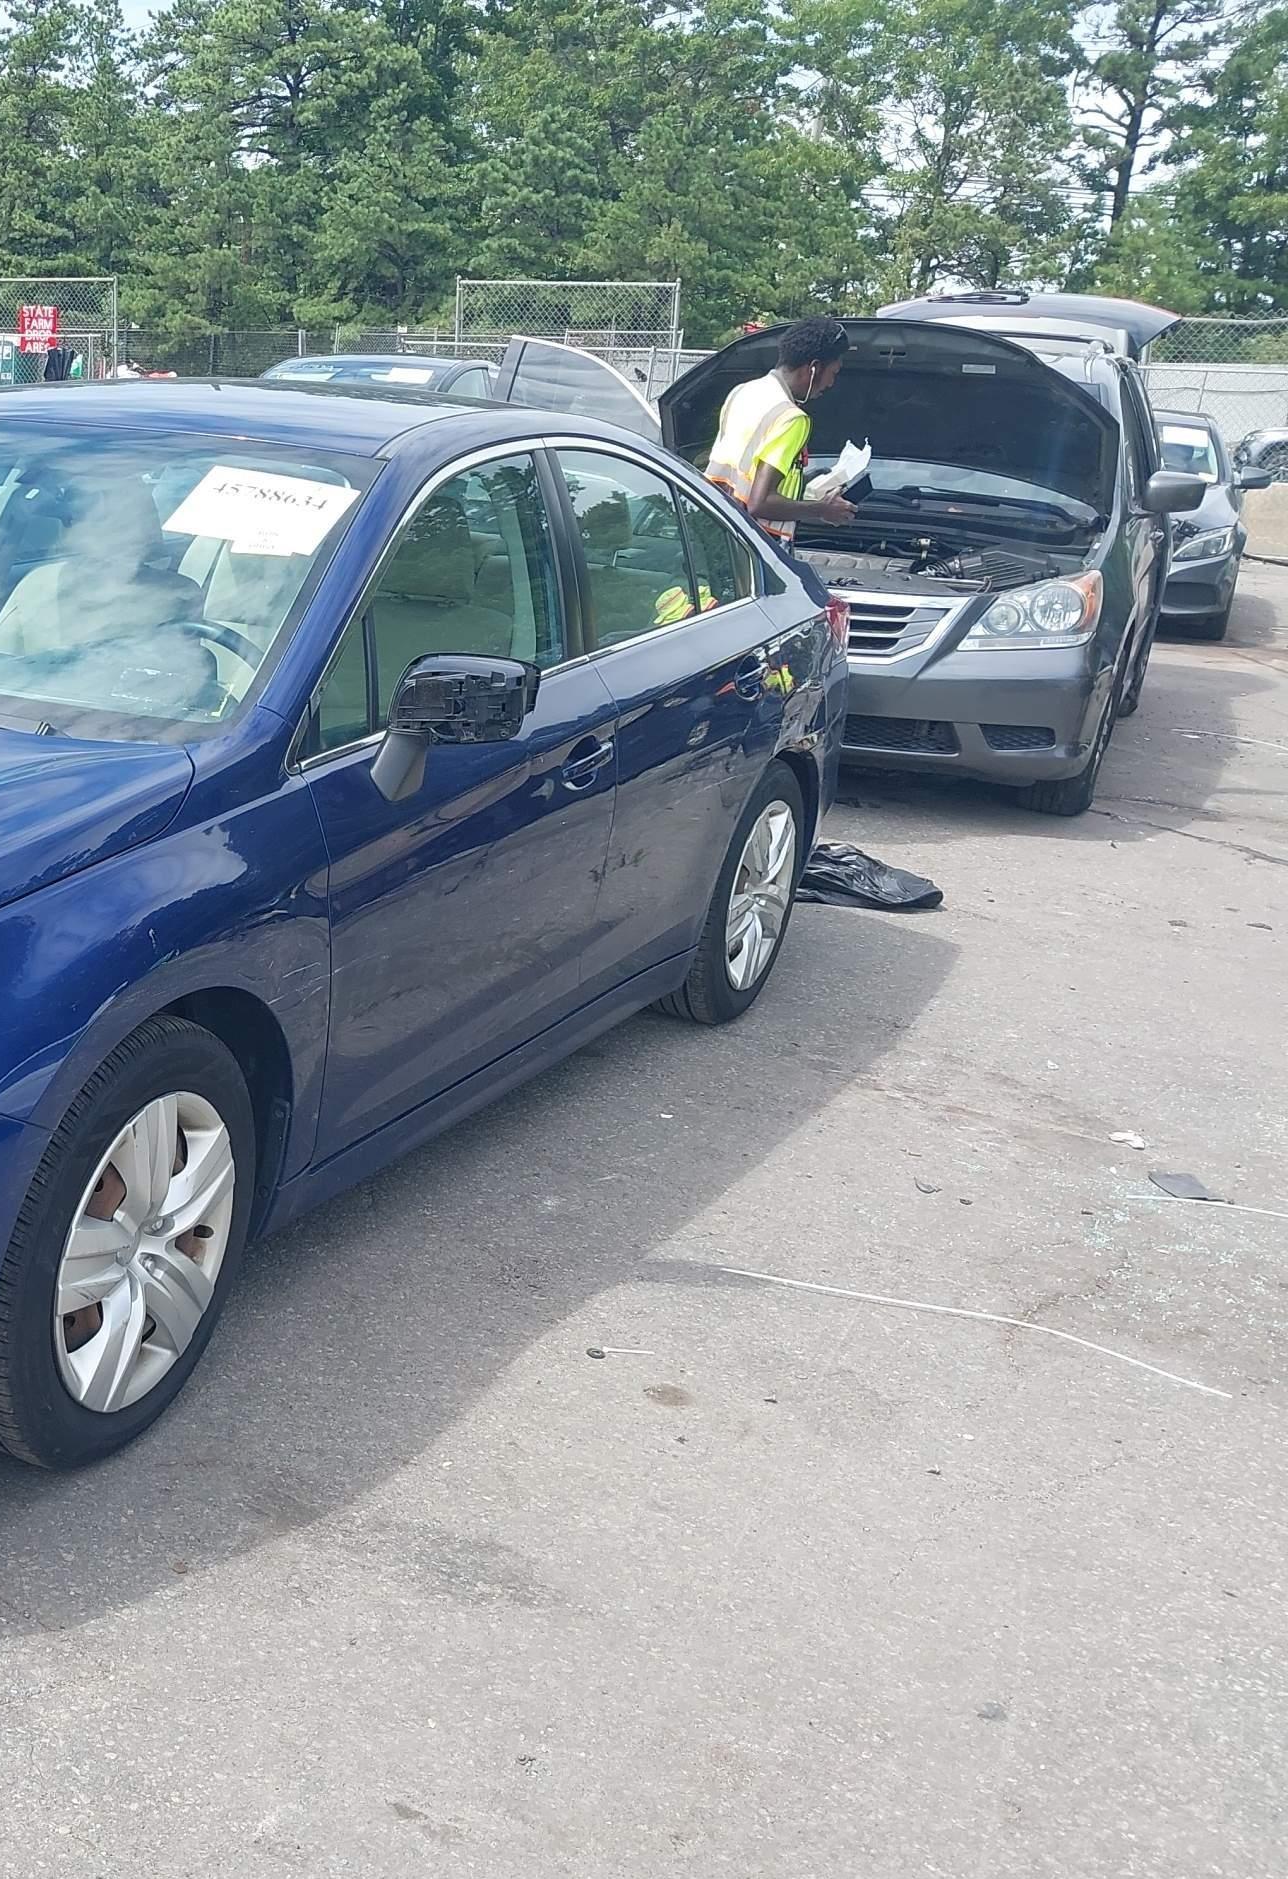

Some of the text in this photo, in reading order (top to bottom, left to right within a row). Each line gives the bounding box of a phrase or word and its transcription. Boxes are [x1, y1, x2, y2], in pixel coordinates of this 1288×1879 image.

[22, 305, 54, 318] STATE
[24, 317, 53, 330] FARM
[25, 329, 52, 341] DROP
